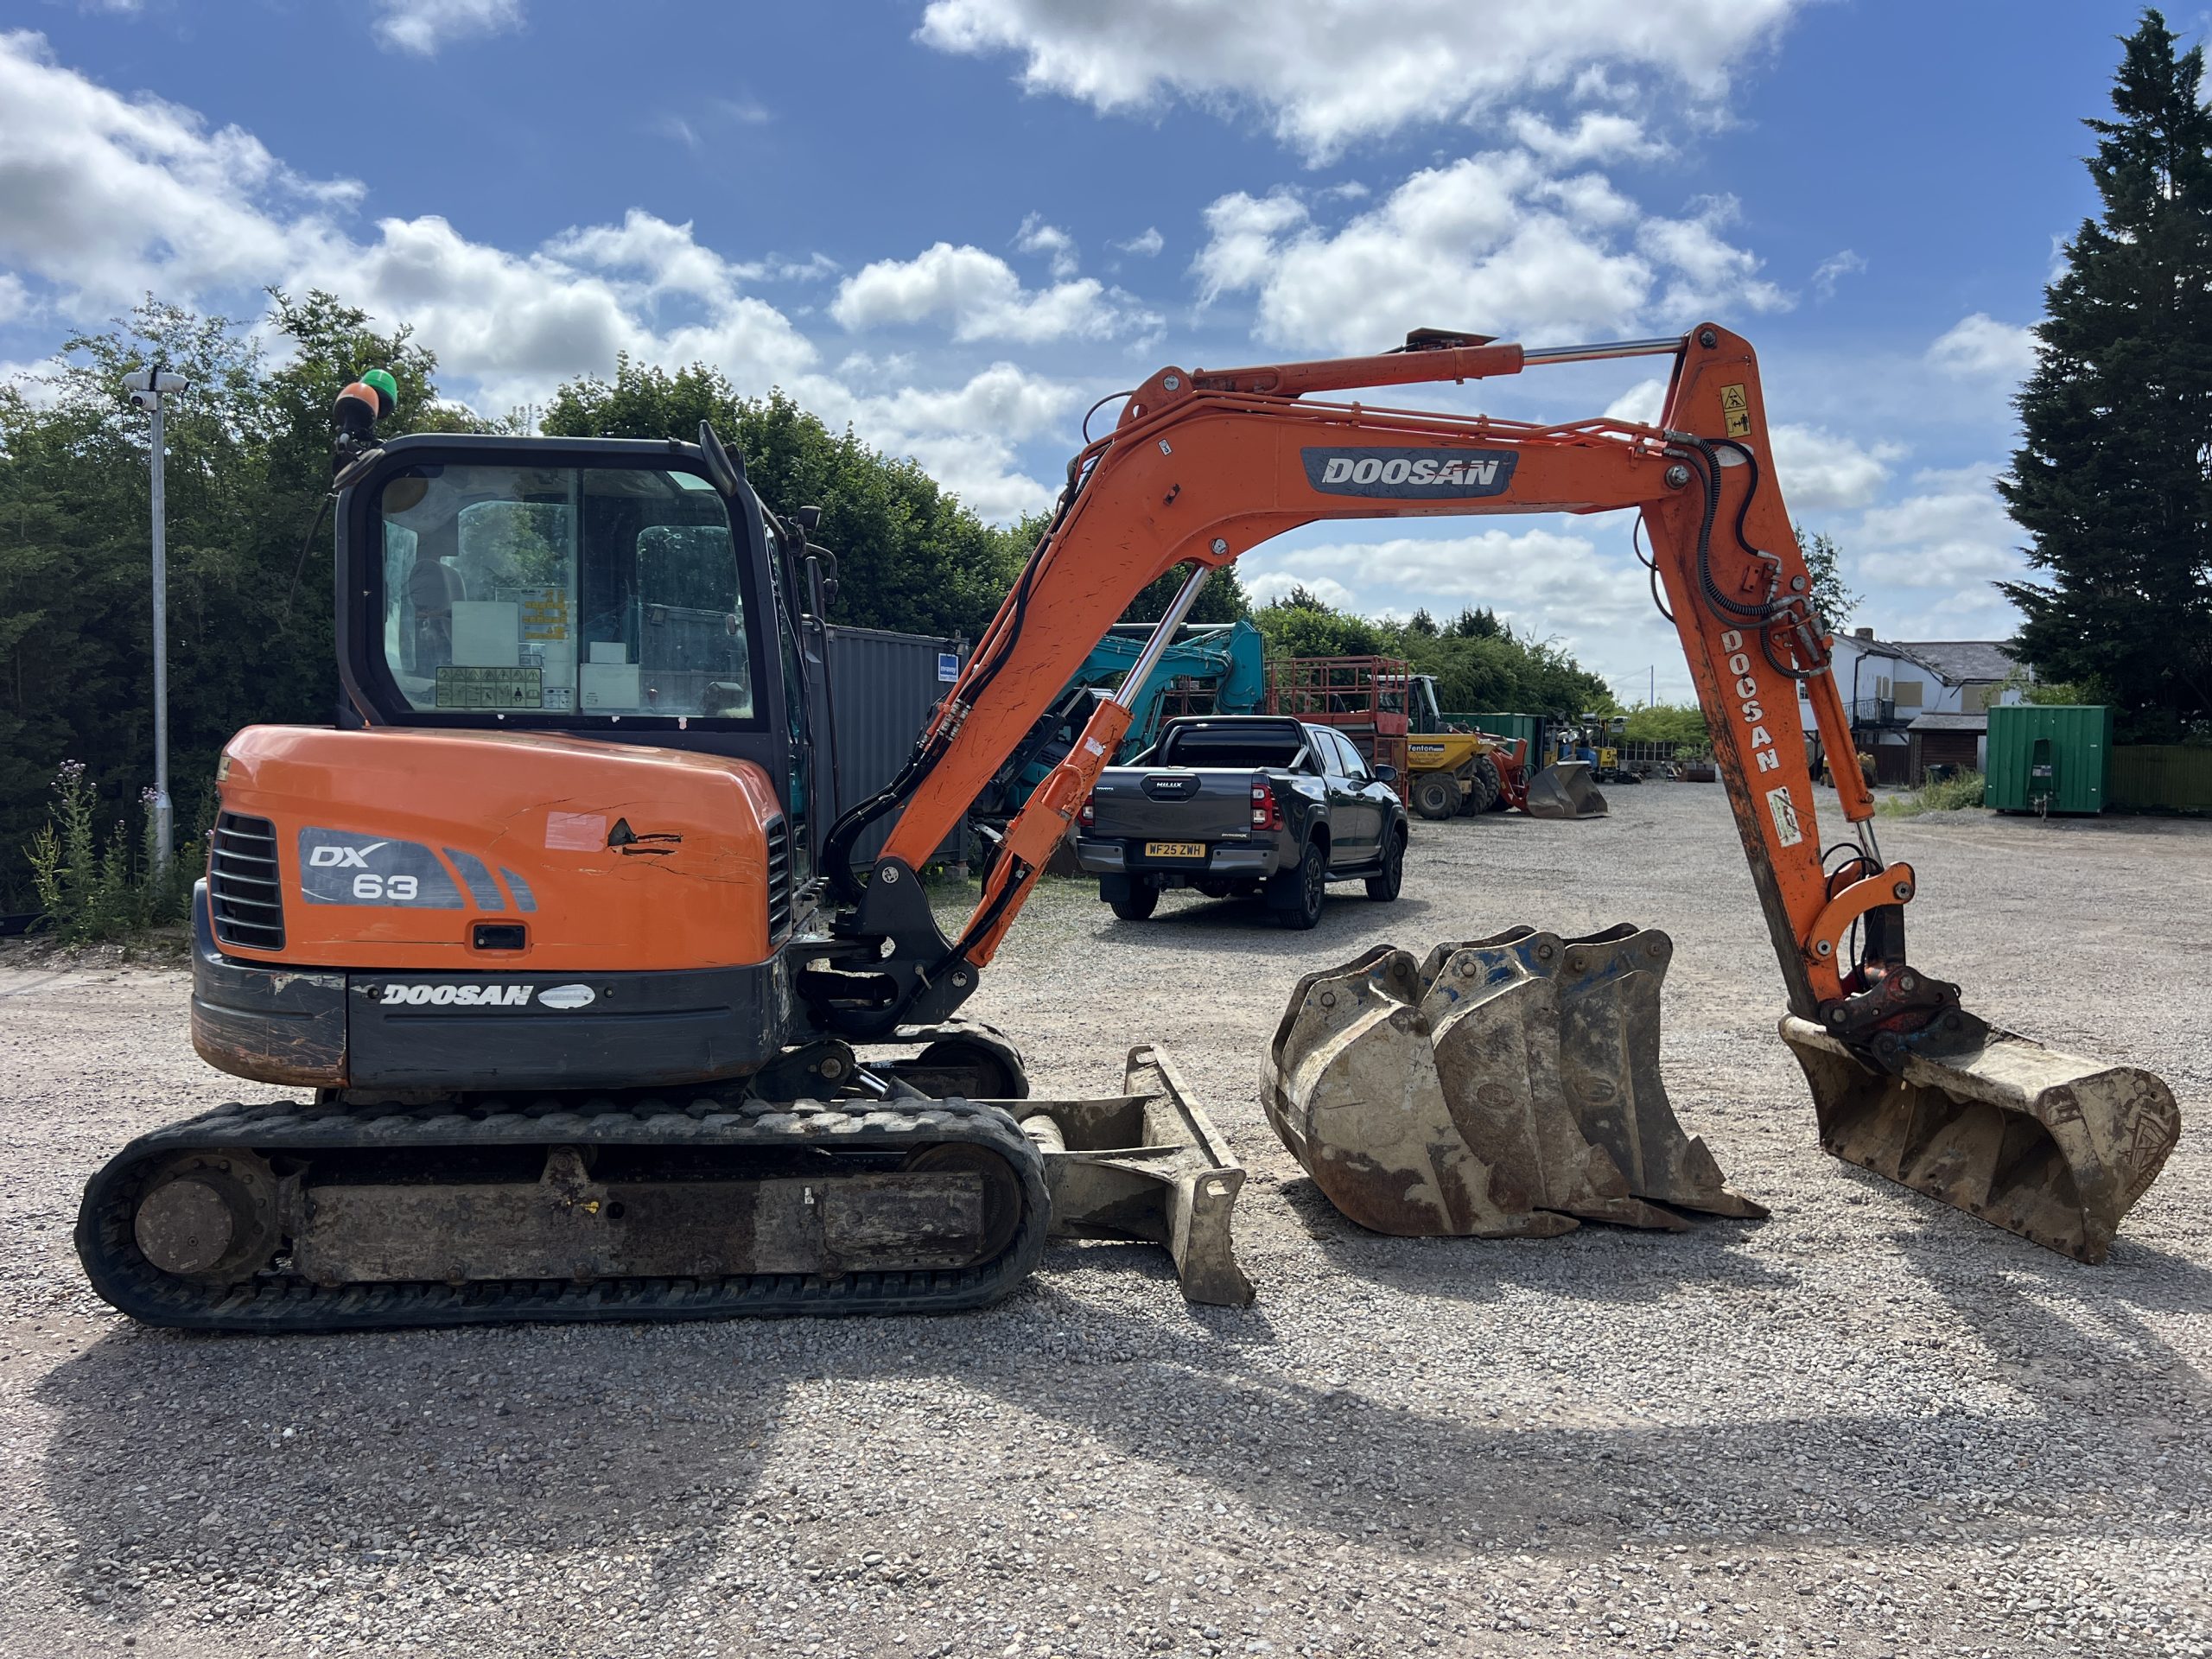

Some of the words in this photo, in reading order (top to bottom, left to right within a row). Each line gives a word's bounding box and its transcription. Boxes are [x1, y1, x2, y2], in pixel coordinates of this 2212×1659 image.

[1321, 458, 1499, 485] DOOSAN
[1720, 629, 1780, 773] DOOSAN
[309, 842, 390, 868] DX
[1149, 845, 1177, 855] WF25
[1179, 845, 1201, 855] ZWH
[353, 874, 418, 900] 63
[379, 984, 534, 1006] DOOSAN
